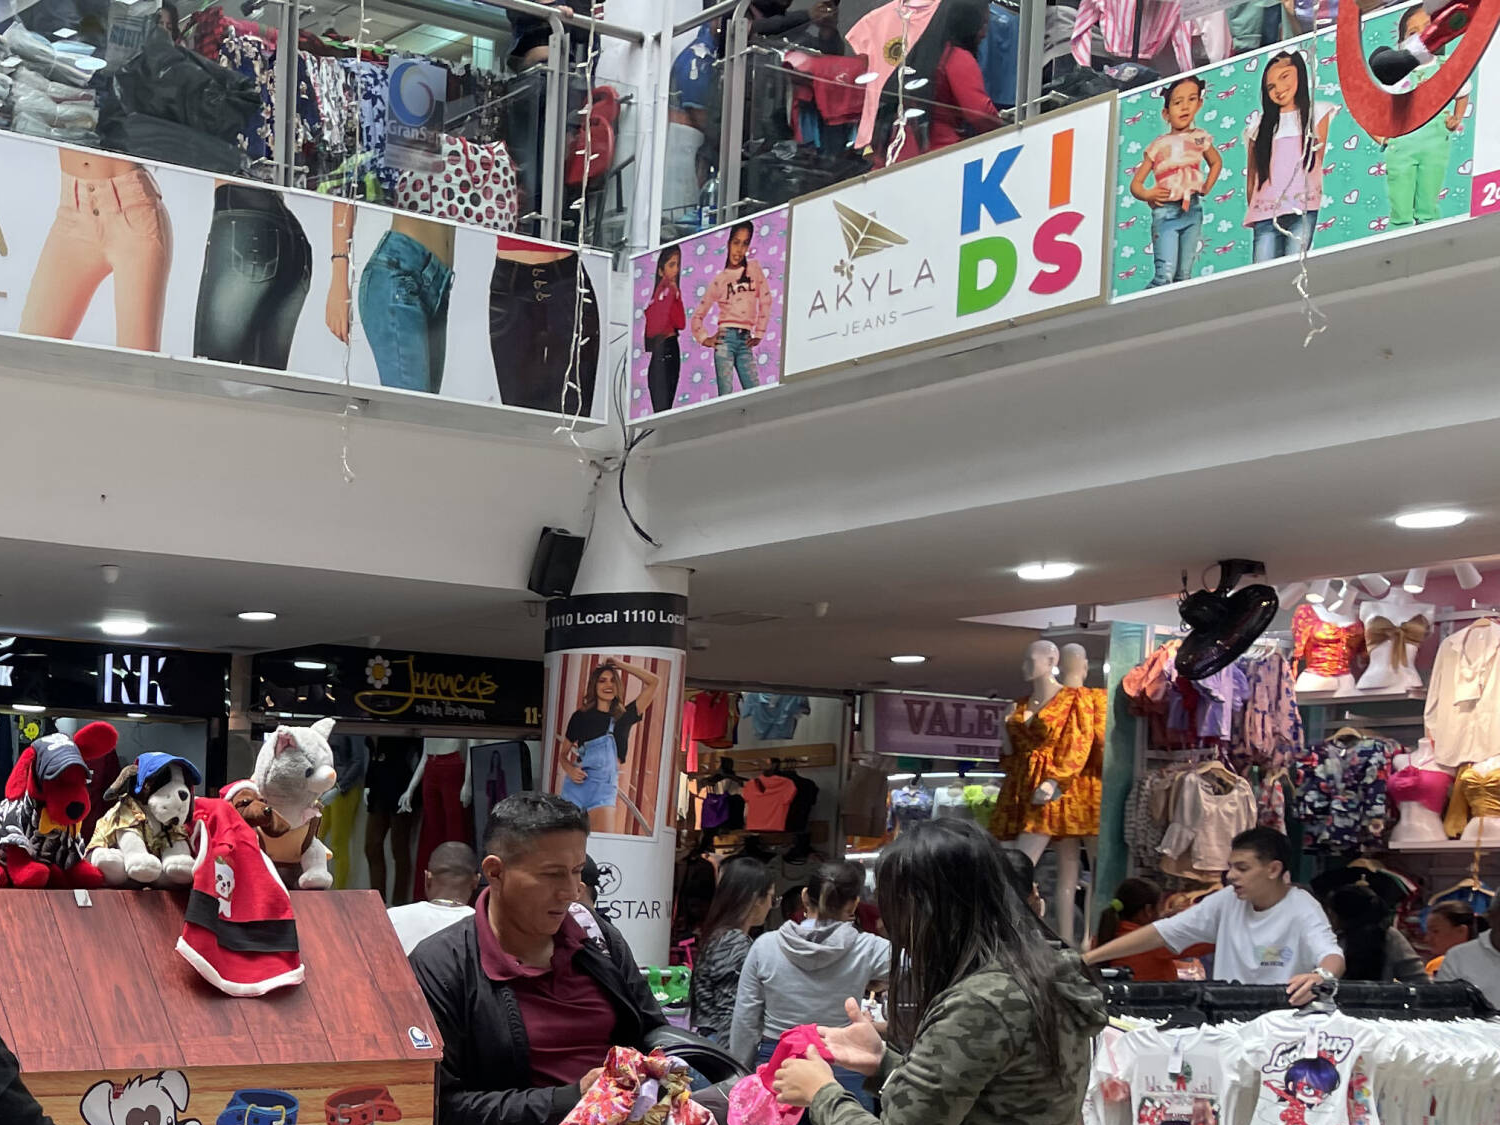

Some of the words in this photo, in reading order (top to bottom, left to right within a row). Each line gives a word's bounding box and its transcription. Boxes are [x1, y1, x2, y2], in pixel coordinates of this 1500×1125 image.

[808, 258, 935, 319] AKYLA
[842, 311, 898, 338] JEANS
[552, 613, 573, 628] 1110
[576, 610, 618, 625] Local
[623, 609, 656, 623] 1110
[659, 610, 685, 626] Loca
[903, 699, 1004, 739] VALE
